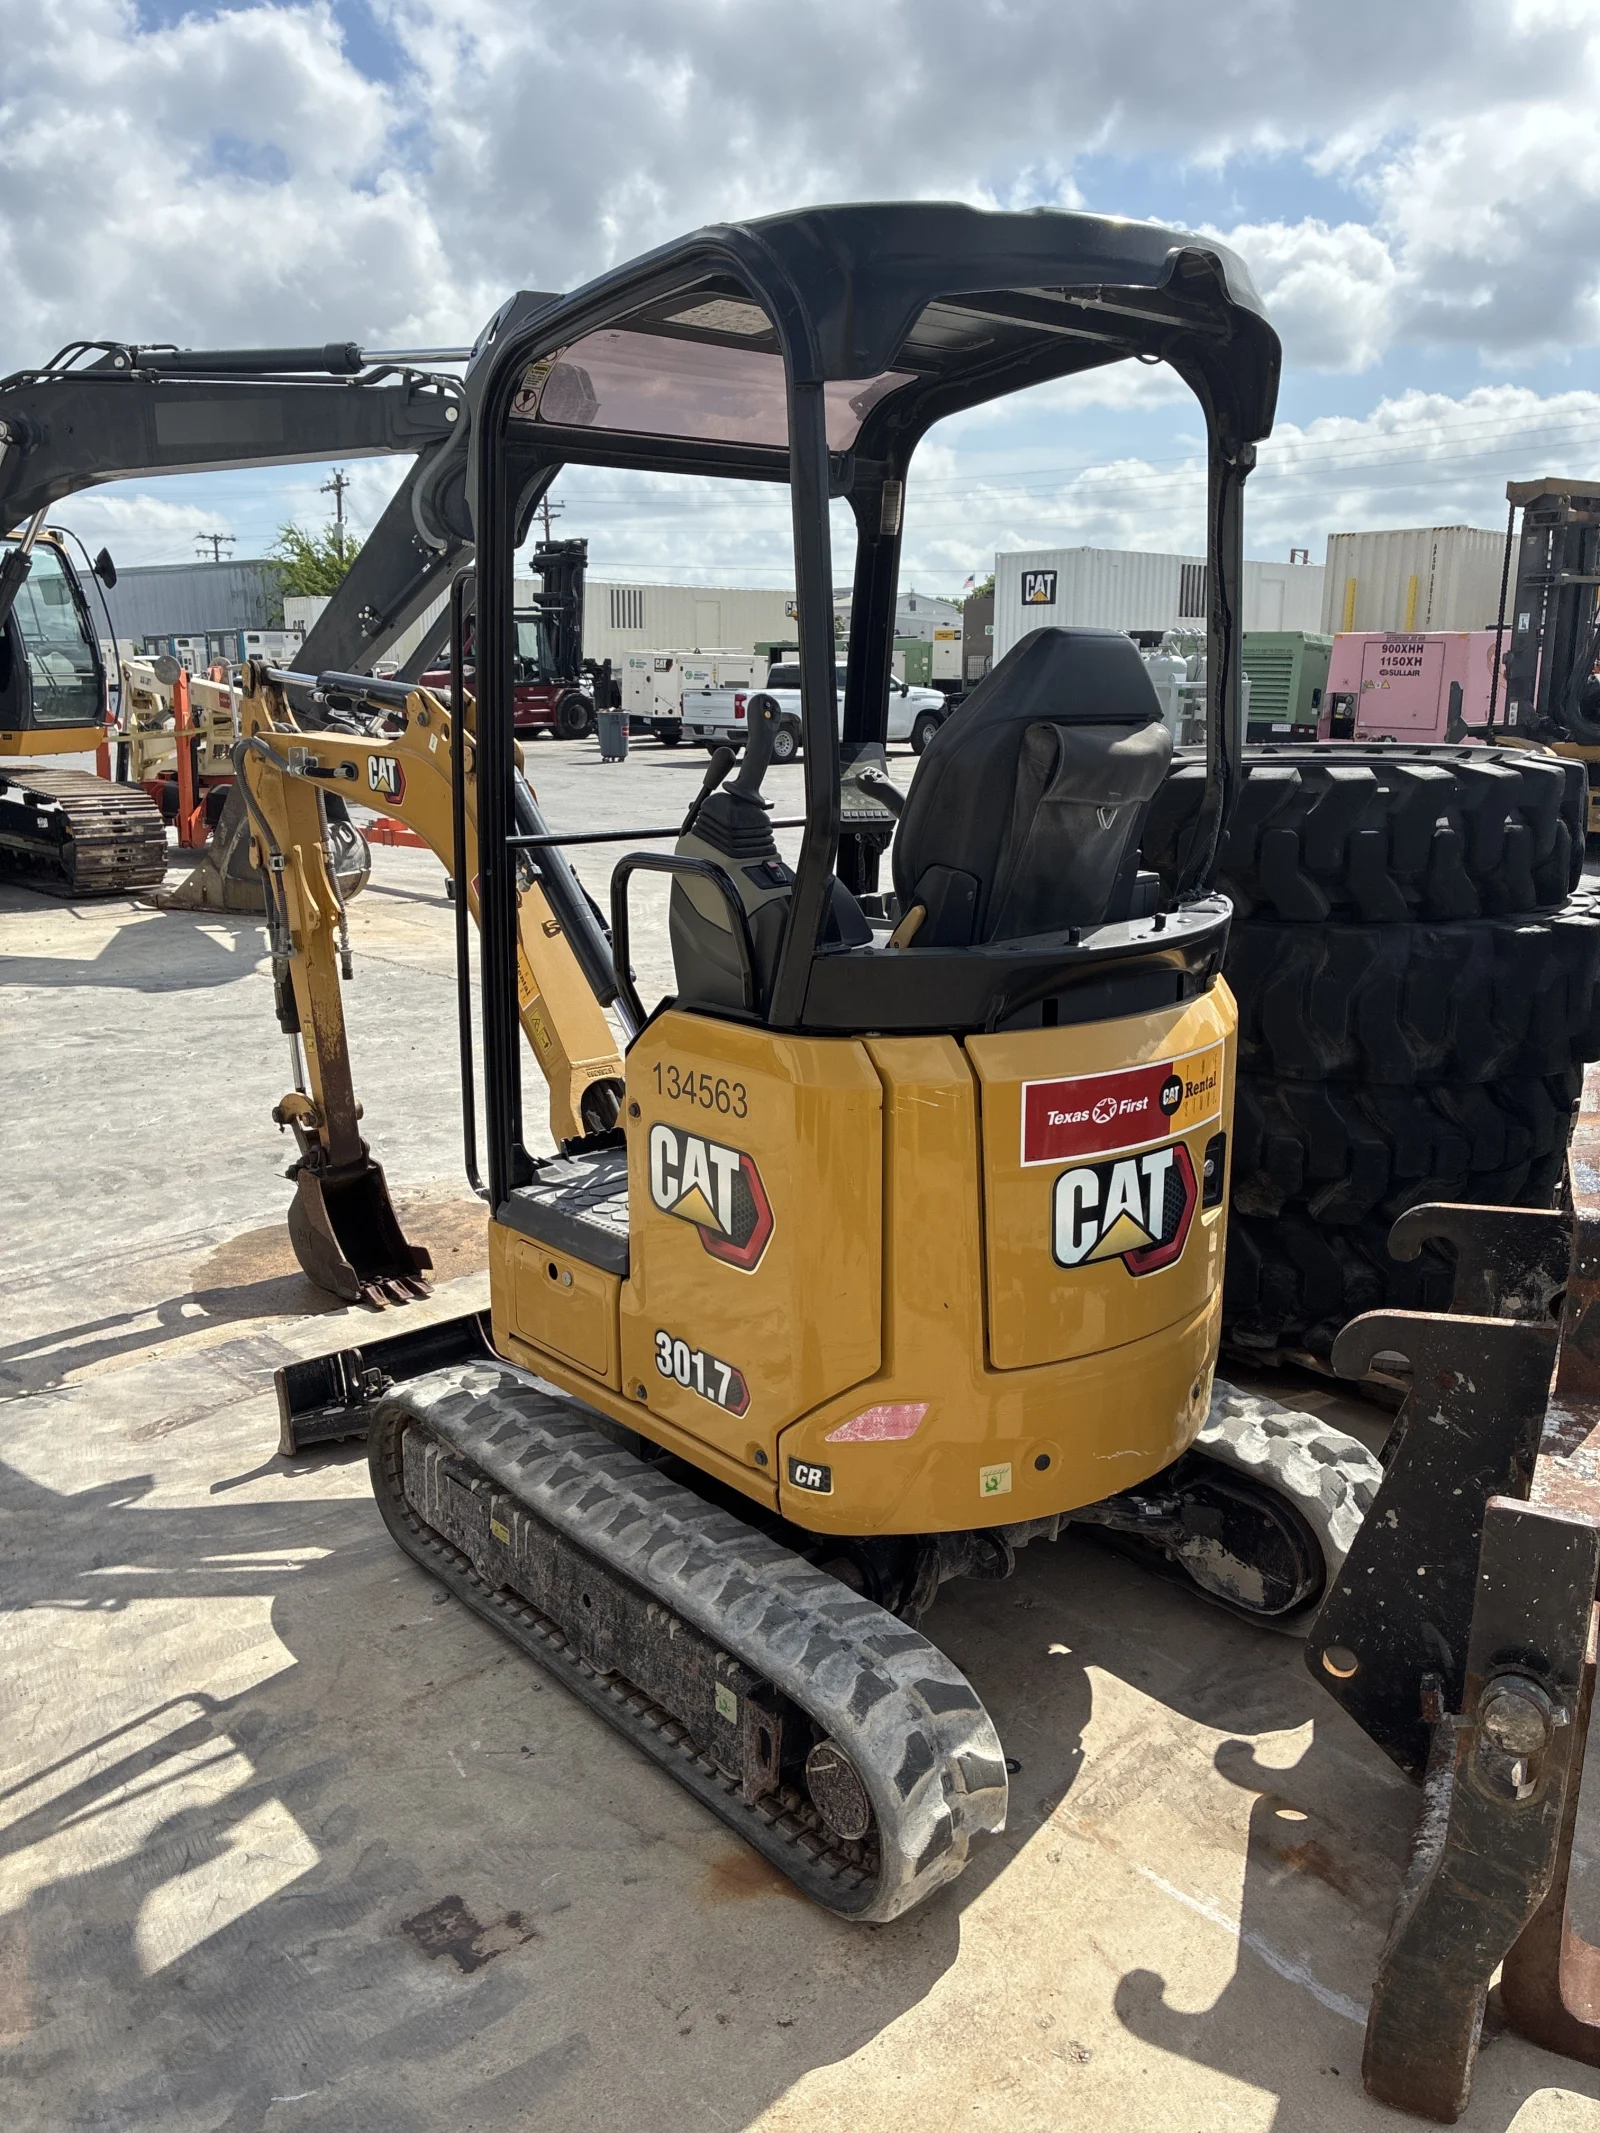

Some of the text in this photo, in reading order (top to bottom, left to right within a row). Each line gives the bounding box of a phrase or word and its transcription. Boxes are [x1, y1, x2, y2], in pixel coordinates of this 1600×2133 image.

[1026, 574, 1054, 601] CAT
[1380, 657, 1422, 666] 1150XH
[1381, 644, 1424, 653] 900XHH
[655, 659, 667, 669] CAT
[368, 756, 395, 793] CAT
[653, 1062, 748, 1118] 134563
[1162, 1086, 1180, 1105] CAT
[1184, 1071, 1217, 1098] Rental
[1047, 1097, 1149, 1125] Texas First
[651, 1125, 740, 1236] CAT
[1055, 1147, 1174, 1265] CAT
[655, 1331, 732, 1406] 301.7
[795, 1464, 823, 1488] CR
